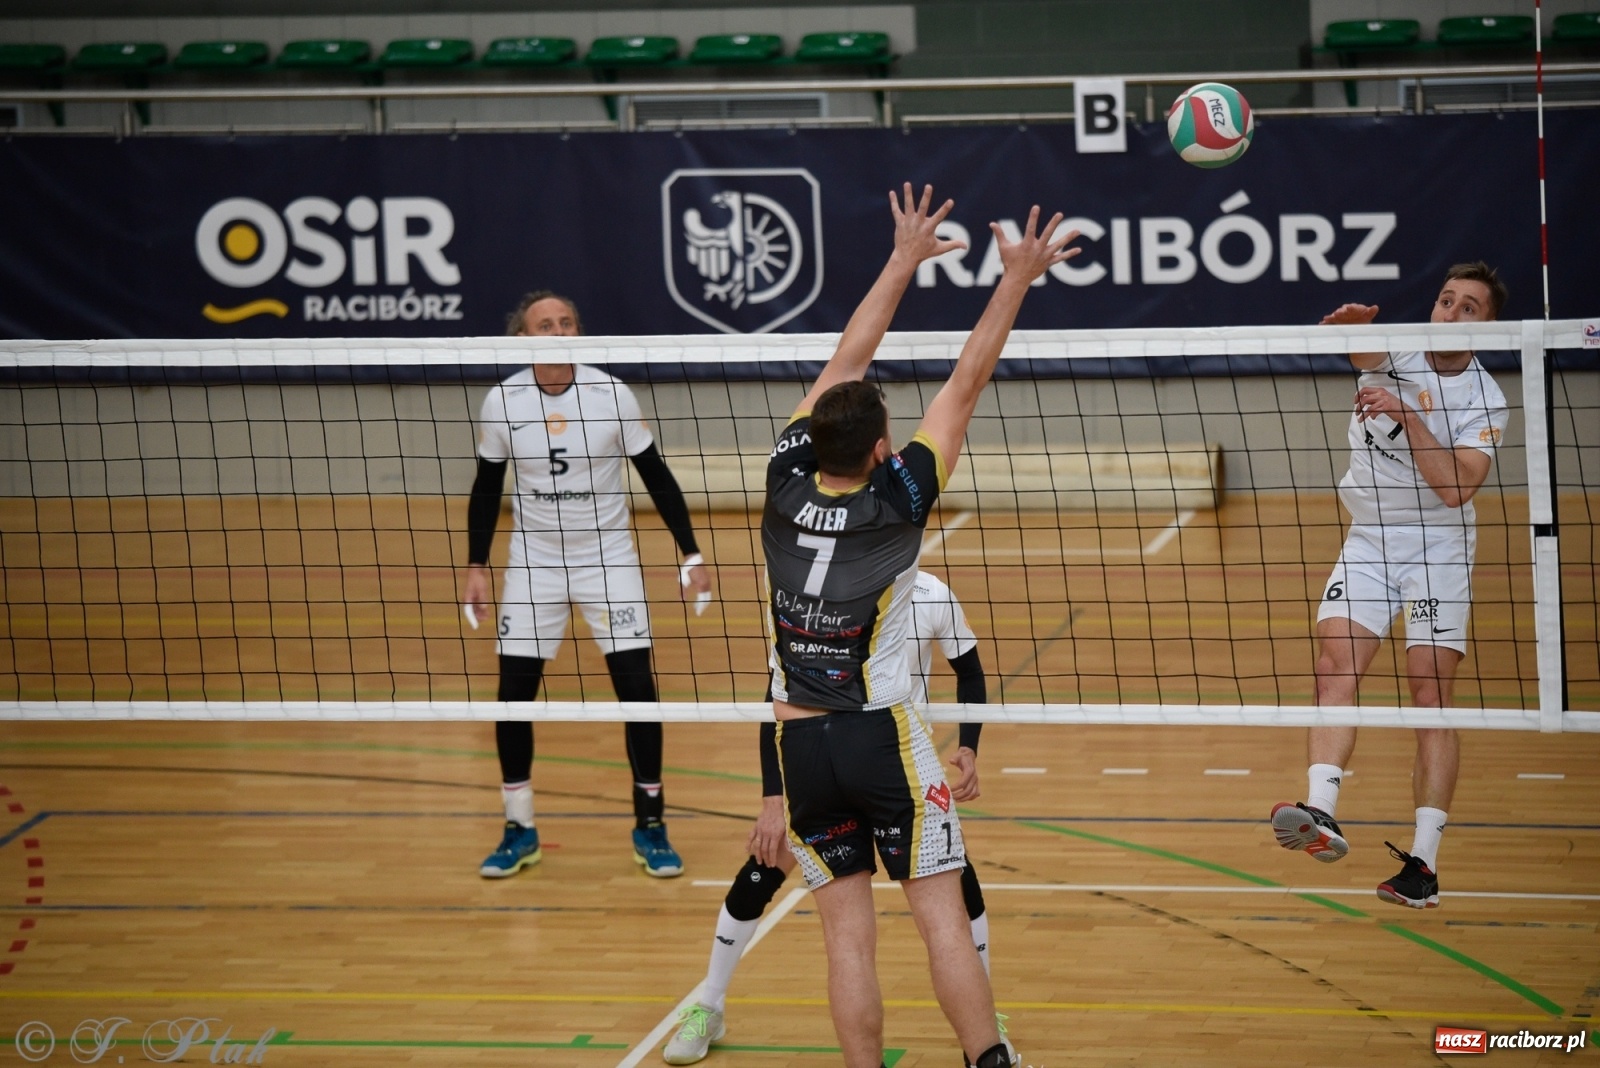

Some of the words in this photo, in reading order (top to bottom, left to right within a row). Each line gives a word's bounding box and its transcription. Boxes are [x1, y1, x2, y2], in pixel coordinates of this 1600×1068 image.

[1083, 93, 1119, 136] B
[1208, 98, 1226, 128] MECZ
[916, 189, 1400, 288] RACIBÓRZ
[303, 287, 464, 321] RACIBÓRZ
[549, 447, 569, 476] 5
[793, 501, 848, 531] ENTER
[796, 532, 837, 597] 7
[1326, 580, 1344, 601] 6
[1411, 598, 1440, 610] ZOO
[500, 615, 511, 636] 5
[1410, 607, 1439, 620] MAR
